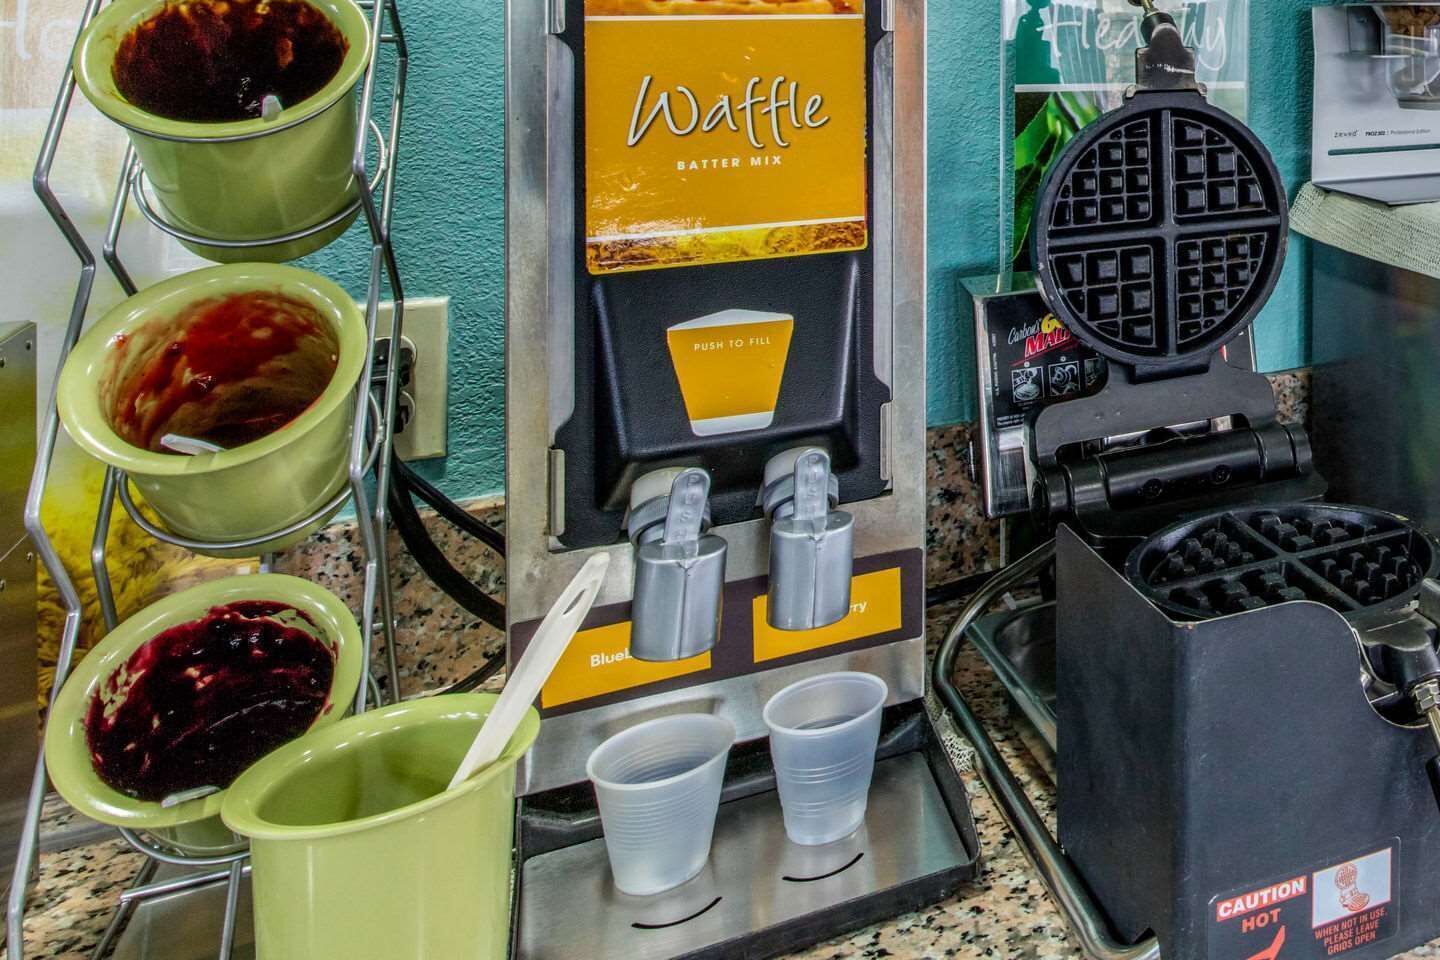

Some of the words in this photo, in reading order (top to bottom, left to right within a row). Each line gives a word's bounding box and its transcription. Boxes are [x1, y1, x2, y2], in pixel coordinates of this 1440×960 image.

[627, 75, 830, 148] Waffle
[676, 158, 740, 170] BATTER
[750, 156, 781, 166] MIX
[694, 342, 723, 351] PUSH
[729, 339, 744, 348] TO
[749, 336, 771, 346] FILL
[590, 647, 632, 668] Blue
[1218, 878, 1305, 918] CAUTION
[1242, 908, 1281, 933] HOT
[1315, 924, 1339, 939] WHEN
[1341, 918, 1357, 932] NOT
[1359, 914, 1368, 925] IN
[1324, 928, 1354, 947] PLEASE
[1356, 920, 1379, 936] LEAVE
[1327, 940, 1353, 955] GRIDS
[1354, 931, 1376, 946] OPEN
